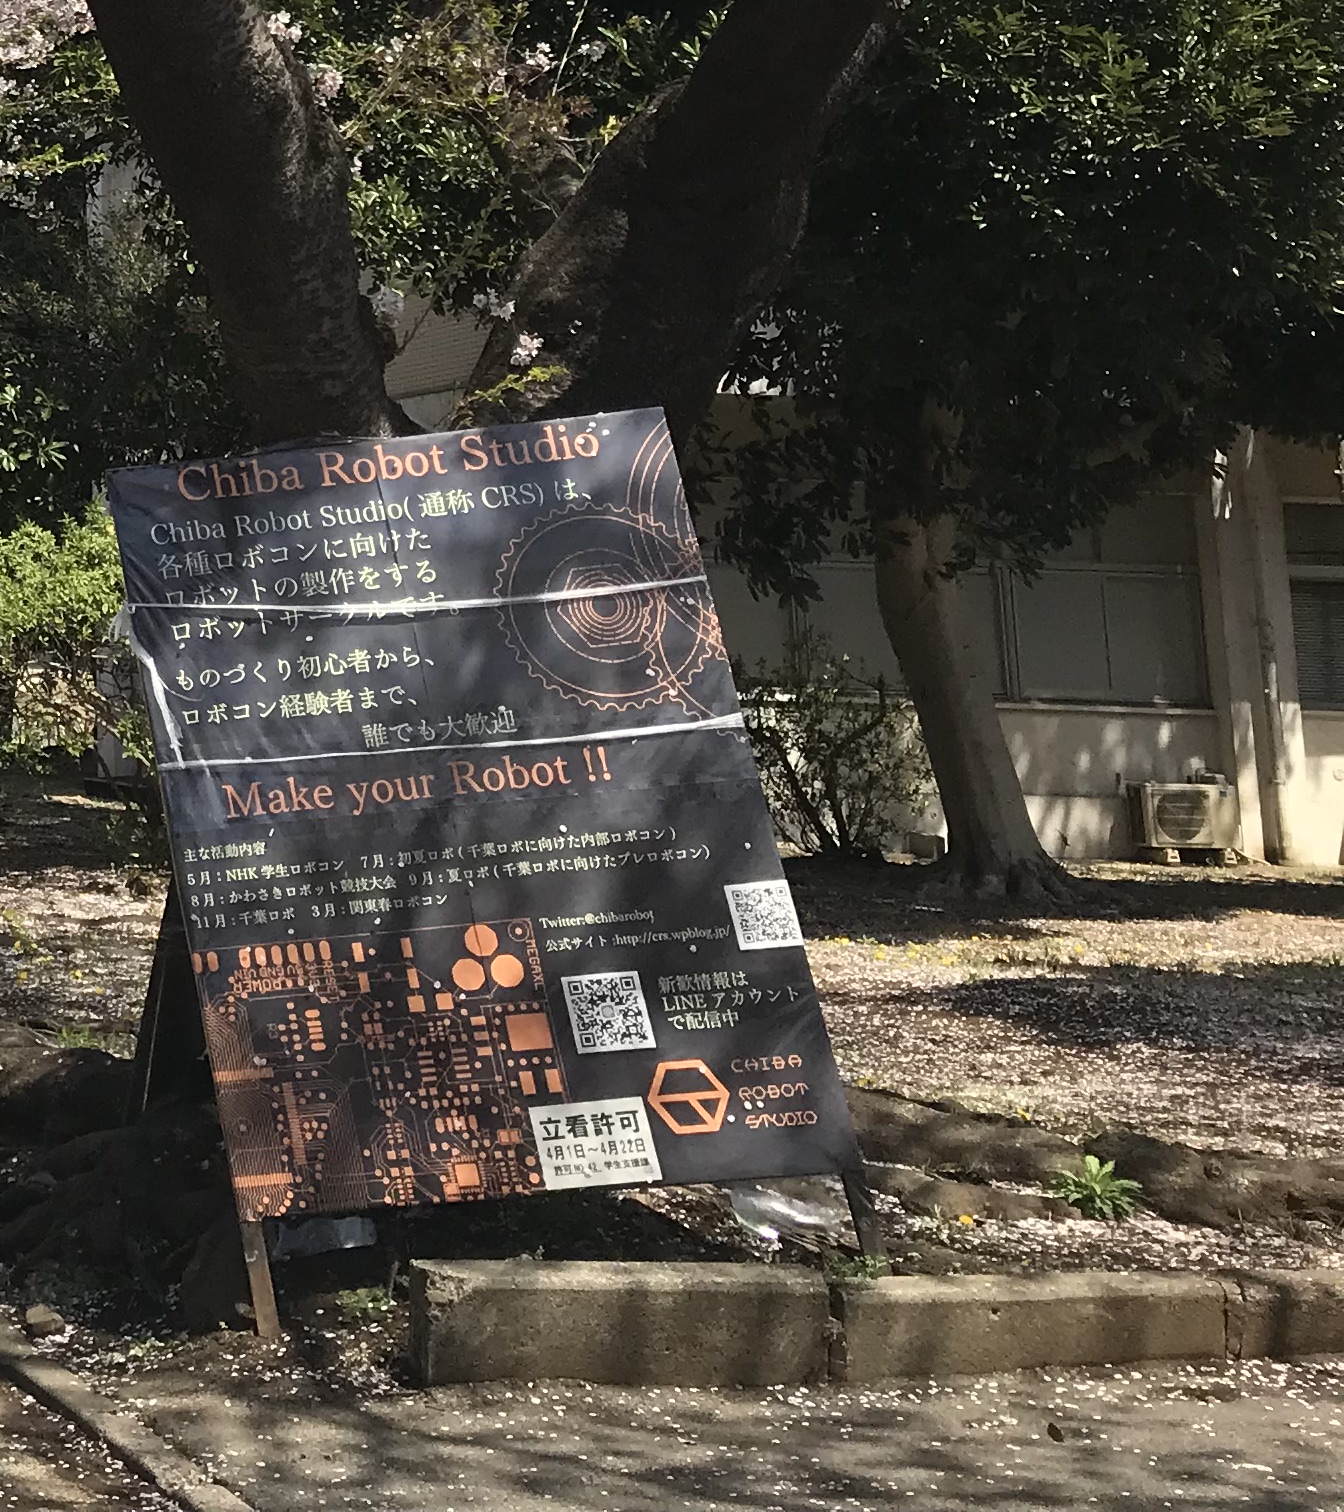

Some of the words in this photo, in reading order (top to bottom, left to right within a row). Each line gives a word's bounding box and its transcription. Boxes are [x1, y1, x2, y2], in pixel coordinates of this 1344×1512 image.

[177, 456, 303, 501] Chiba
[320, 444, 448, 487] Robot
[463, 424, 600, 472] Studio
[150, 515, 227, 547] Chiba
[236, 507, 312, 537] Robot
[158, 527, 432, 581] 各種ロボコンに向けた
[166, 560, 437, 606] ロボットの製作をする
[177, 645, 435, 691] ものづくり初心者から、
[181, 685, 418, 726] ロボコン経験者まで、
[361, 706, 518, 748] 誰でも大歓迎
[222, 776, 334, 819] Make
[346, 773, 434, 816] your
[450, 755, 571, 795] Robot
[183, 840, 267, 863] 主な活動内容
[657, 970, 749, 995] 新歓情報は
[667, 1009, 740, 1031] で配信中
[730, 1053, 803, 1074] CHIBA
[738, 1082, 810, 1102] ROBOT
[538, 1109, 641, 1142] 立看許可
[744, 1110, 818, 1130] STUDIO
